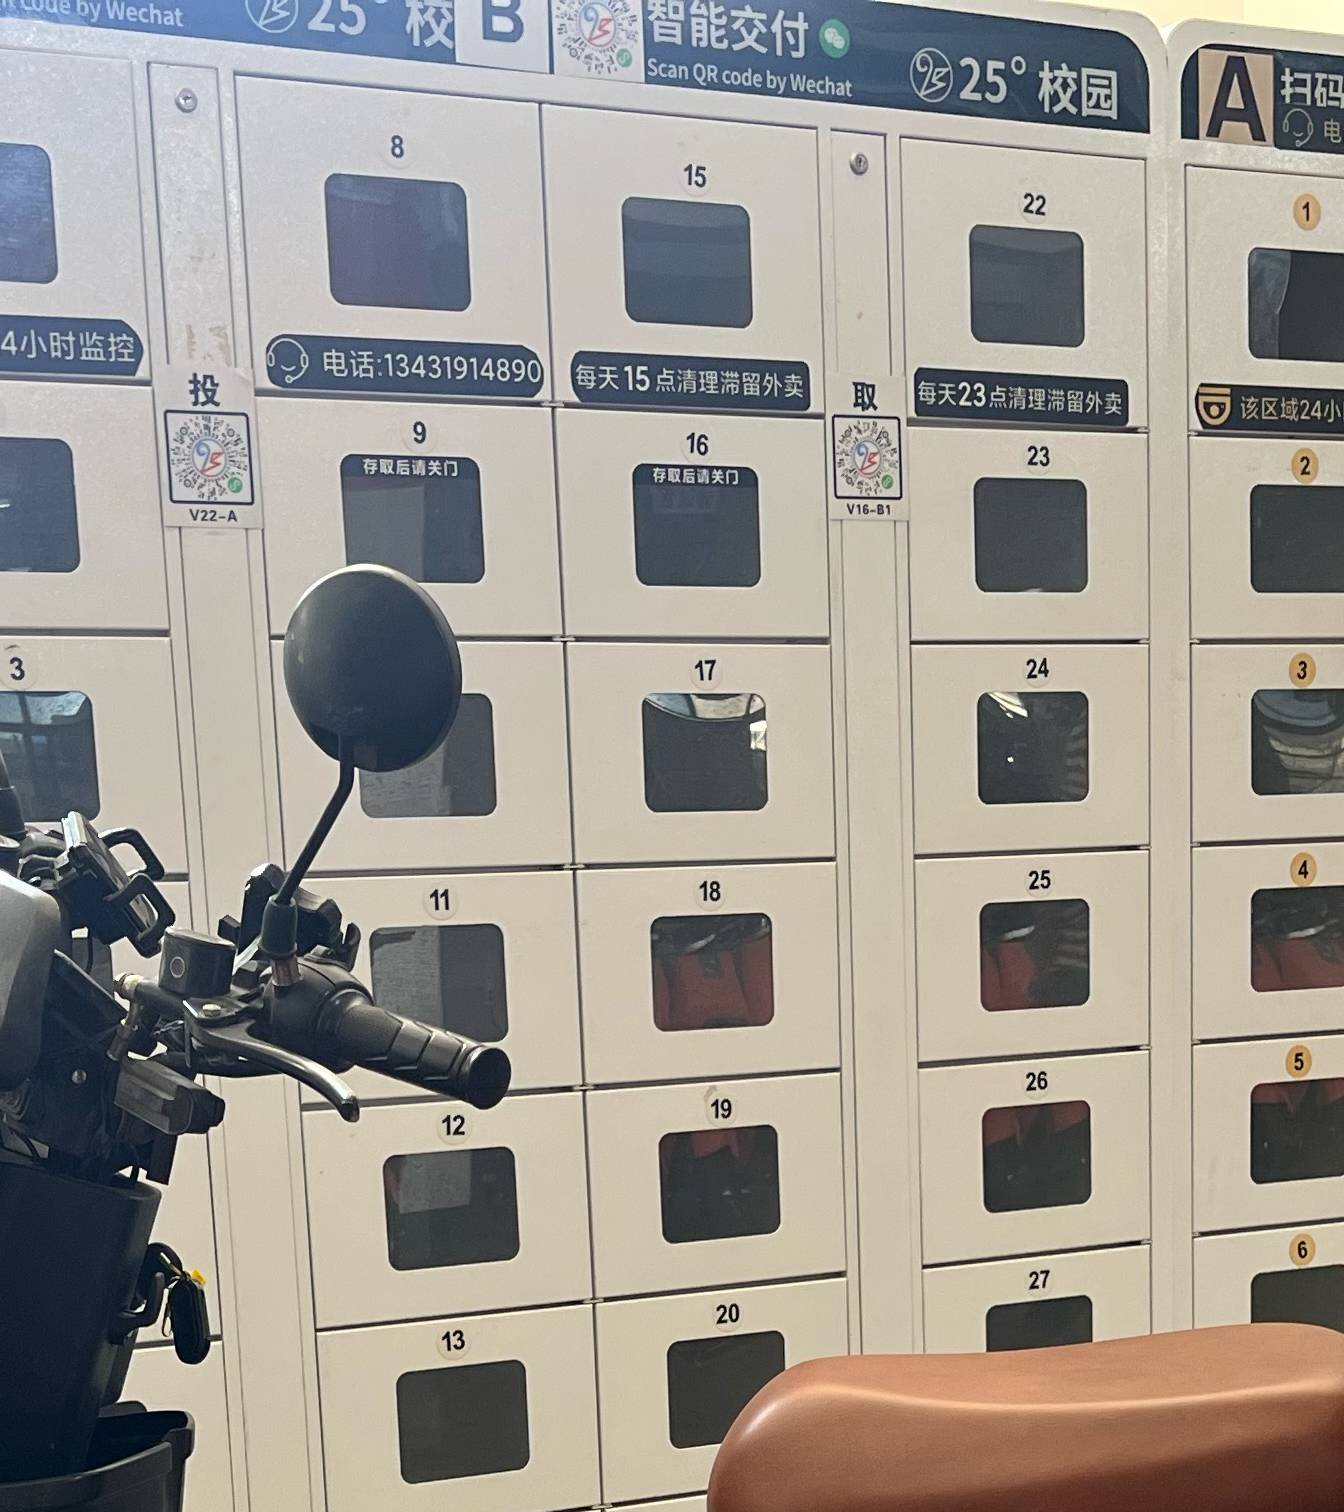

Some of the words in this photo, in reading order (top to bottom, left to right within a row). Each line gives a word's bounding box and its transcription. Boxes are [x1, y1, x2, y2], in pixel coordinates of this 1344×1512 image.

[76, 0, 101, 21] by
[106, 4, 183, 27] Wechat
[647, 0, 808, 58] 智能交付
[647, 57, 689, 80] Scan
[693, 63, 718, 86] QR
[722, 68, 763, 88] code
[766, 70, 787, 95] by
[790, 73, 853, 97] Wechat
[1038, 61, 1118, 120] 校园
[1206, 54, 1267, 143] A
[390, 135, 404, 159] 8
[684, 164, 707, 188] 15
[1023, 193, 1046, 216] 22
[1302, 202, 1310, 222] 1
[188, 373, 221, 408] 投
[575, 364, 804, 399] 每天15点清理滞留外卖
[853, 381, 879, 412] 取
[918, 381, 1123, 416] 每天23点清理滞留外卖
[412, 422, 426, 445] 9
[686, 432, 709, 456] 16
[1027, 446, 1050, 467] 23
[1300, 456, 1311, 475] 2
[362, 458, 459, 477] 存取后请关门
[652, 467, 739, 486] 存取后请关门
[189, 508, 238, 523] V22-A
[9, 656, 25, 681] 3
[694, 659, 717, 681] 17
[1026, 658, 1049, 679] 24
[1297, 662, 1307, 679] 3
[1298, 860, 1309, 879] 4
[1029, 870, 1051, 891] 25
[430, 889, 451, 911] 11
[699, 881, 721, 902] 18
[1293, 1052, 1304, 1071] 5
[1026, 1071, 1048, 1092] 26
[710, 1099, 732, 1120] 19
[442, 1116, 466, 1137] 12
[1297, 1241, 1308, 1260] 6
[1028, 1270, 1050, 1291] 27
[716, 1304, 740, 1325] 20
[442, 1331, 466, 1352] 13
